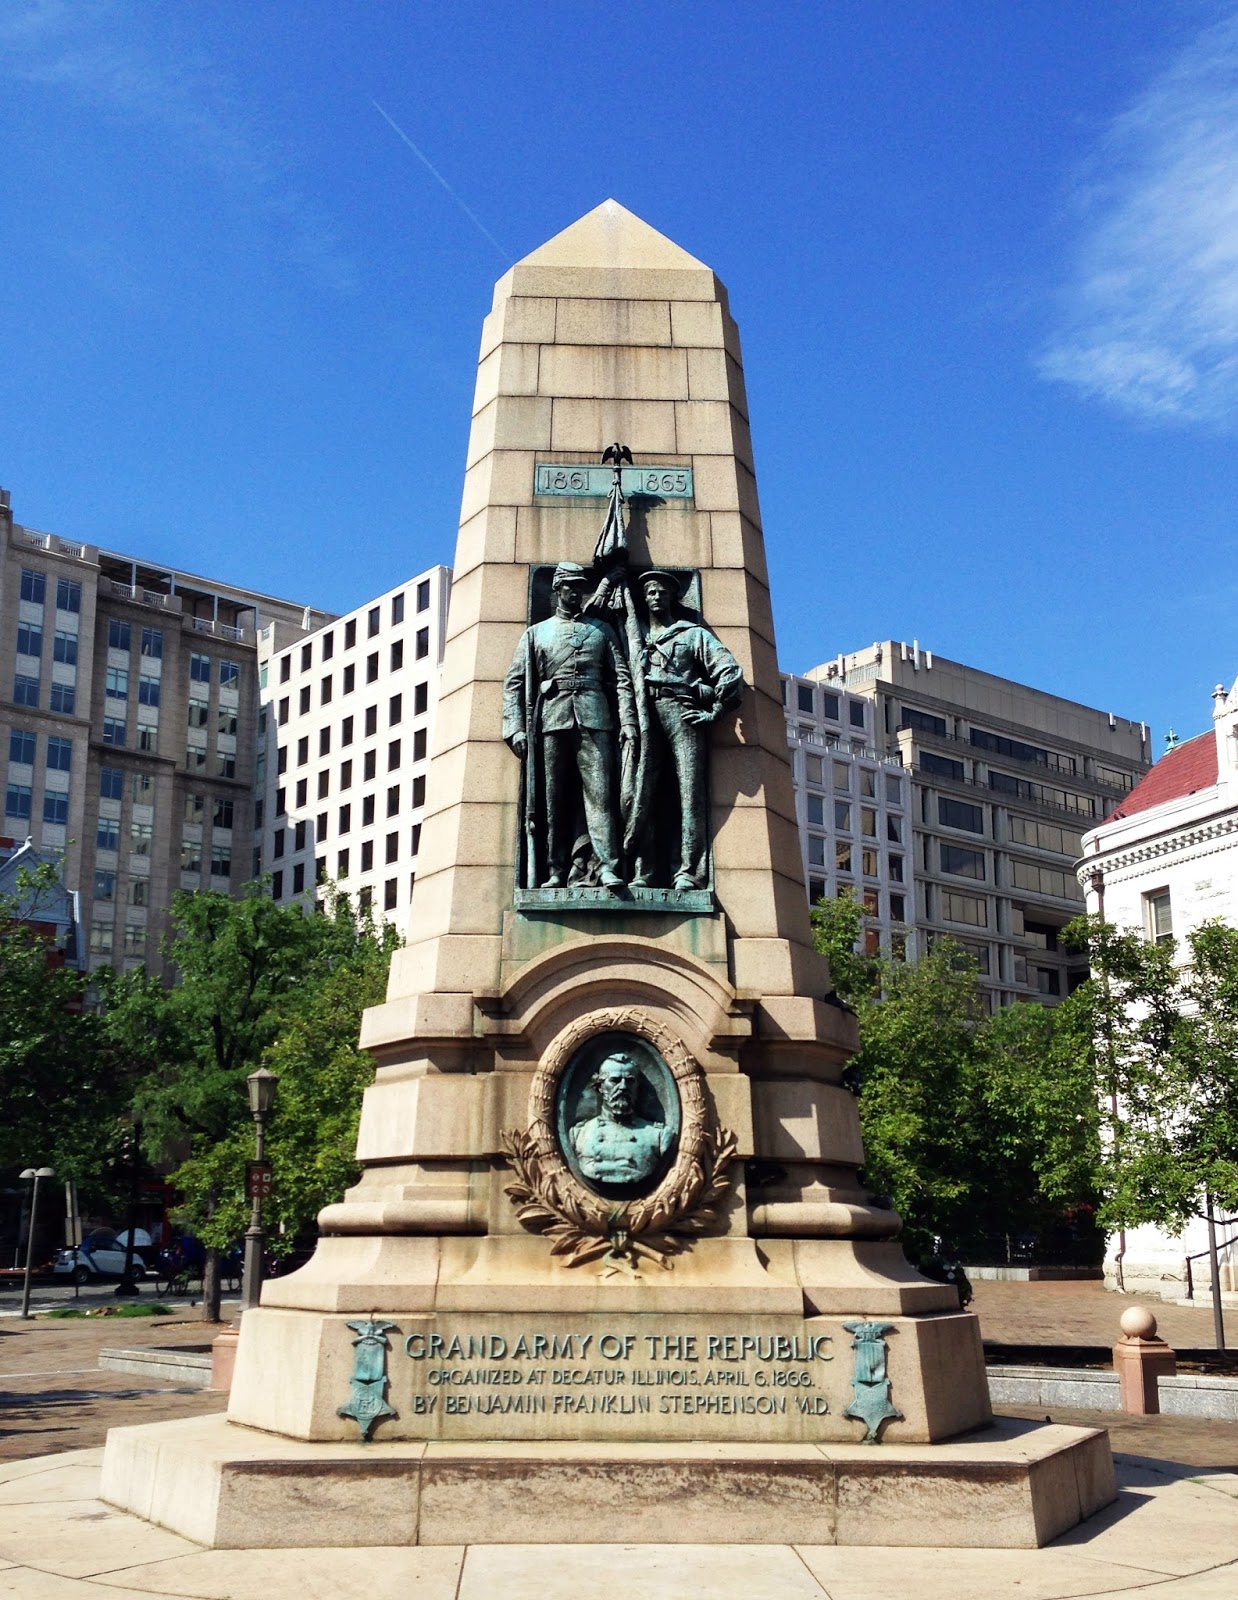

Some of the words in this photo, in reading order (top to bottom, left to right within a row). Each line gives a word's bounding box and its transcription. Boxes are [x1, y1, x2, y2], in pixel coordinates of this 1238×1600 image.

[544, 470, 590, 491] 1861
[638, 472, 687, 493] 1865
[553, 890, 682, 902] FRATENITY
[405, 1333, 507, 1360] GRAND
[511, 1334, 593, 1360] ARMY
[599, 1334, 636, 1361] OF
[645, 1335, 699, 1362] THE
[706, 1335, 834, 1362] REPUBLIC
[428, 1369, 522, 1386] ORGANIZED
[526, 1369, 547, 1385] AT
[551, 1370, 625, 1386] DECATUR
[704, 1369, 749, 1386] APRIL
[413, 1394, 438, 1414] BY
[445, 1395, 546, 1415] BENJAMIN
[553, 1395, 651, 1415] FRANKLIN
[660, 1395, 786, 1415] STEPHENSON
